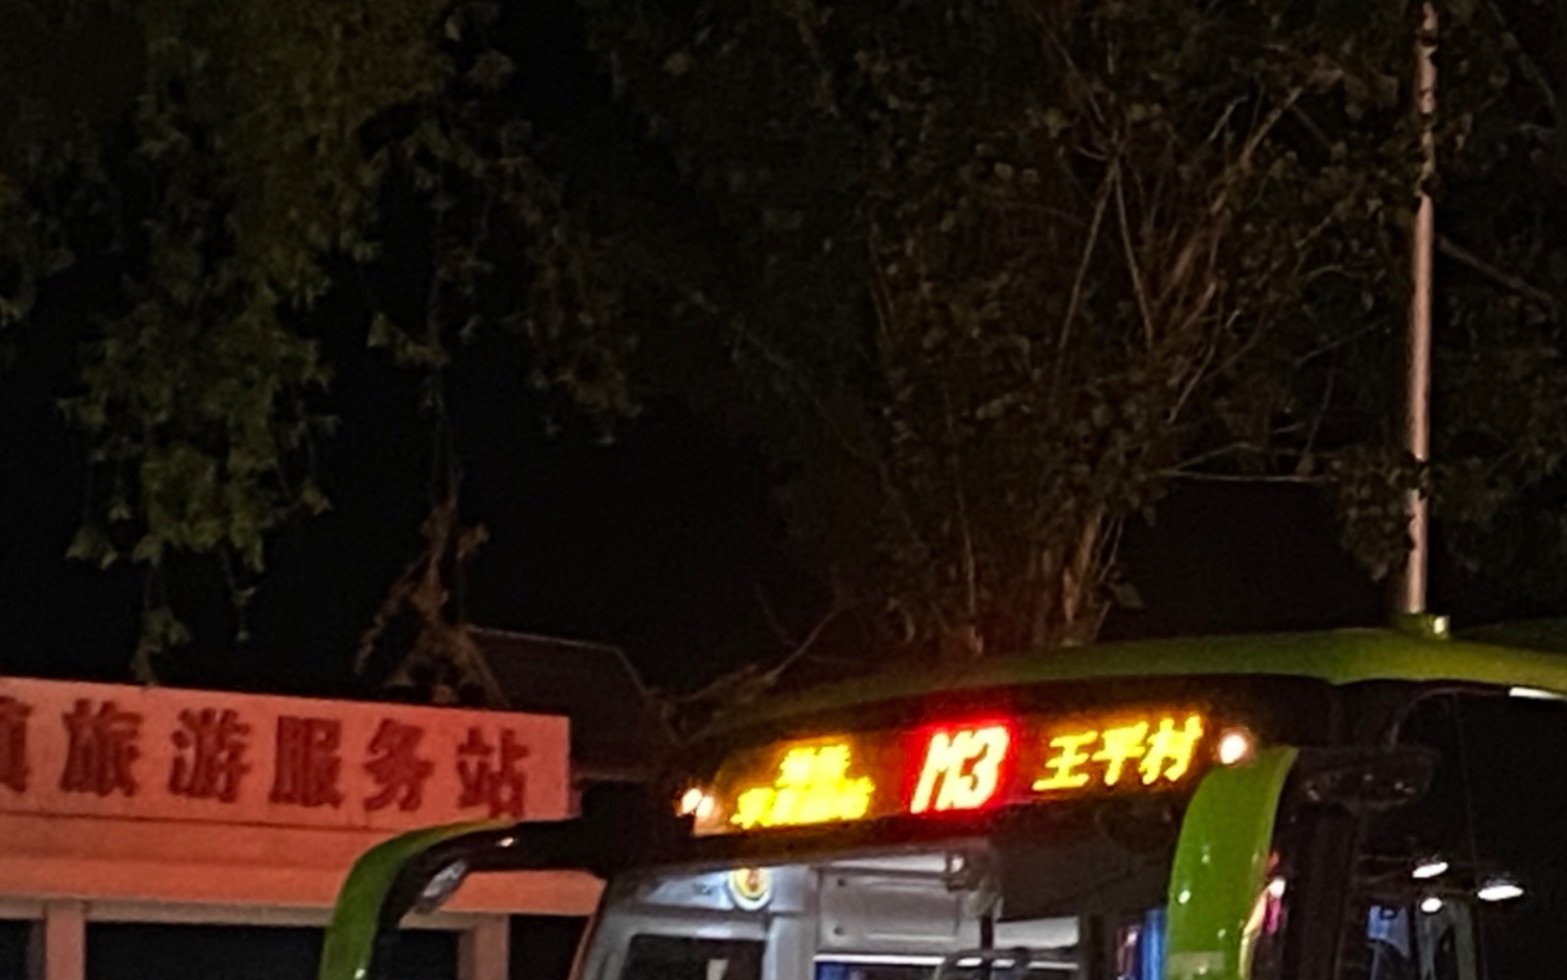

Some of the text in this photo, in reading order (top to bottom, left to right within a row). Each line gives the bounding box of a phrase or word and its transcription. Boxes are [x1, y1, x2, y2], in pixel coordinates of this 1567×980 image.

[910, 726, 1010, 814] M3
[1031, 715, 1202, 792] 王平村
